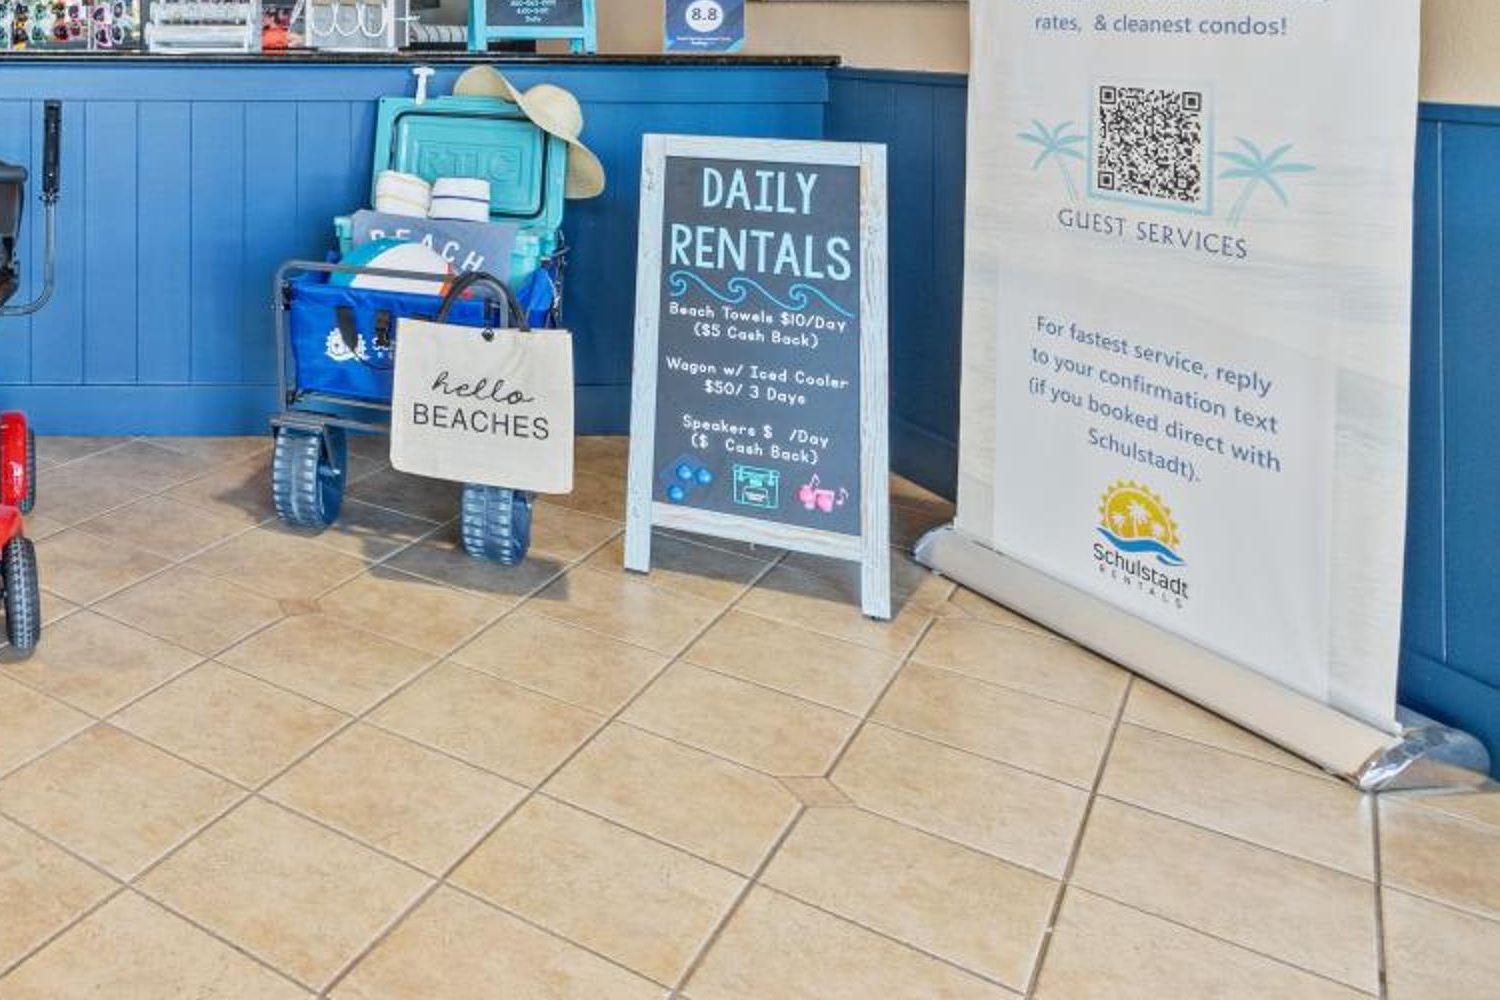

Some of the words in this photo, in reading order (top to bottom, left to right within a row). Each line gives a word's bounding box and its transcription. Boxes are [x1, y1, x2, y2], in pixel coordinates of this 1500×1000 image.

[691, 8, 717, 20] 8.8
[1035, 14, 1081, 33] rates,
[1093, 15, 1108, 31] &
[1113, 14, 1191, 33] cleanest
[1198, 16, 1287, 35] condos!
[702, 168, 818, 215] DAILY
[669, 223, 851, 281] RENTALS
[1058, 209, 1125, 237] GUEST
[1136, 221, 1249, 259] SERVICES
[669, 301, 715, 317] Beach
[722, 306, 774, 323] Towels
[780, 311, 847, 333] $10/Day
[693, 321, 721, 338] ($5
[727, 325, 765, 342] Cash
[771, 330, 819, 349] Back)
[666, 356, 717, 375] Wagon
[723, 365, 743, 377] w/
[750, 366, 787, 383] Iced
[794, 371, 849, 389] Cooler
[1037, 316, 1064, 336] For
[1069, 323, 1128, 355] fastest
[1134, 344, 1209, 380] service,
[1216, 366, 1272, 397] reply
[431, 371, 535, 404] hello
[704, 378, 742, 395] $50/
[749, 385, 759, 399] 3
[767, 387, 805, 405] Days
[1032, 348, 1049, 365] to
[1054, 355, 1094, 377] your
[1099, 368, 1226, 417] confirmation
[1233, 404, 1279, 434] text
[413, 403, 549, 440] BEACHES
[683, 414, 755, 438] Speakers
[763, 424, 773, 440] $
[789, 428, 829, 448] /Day
[1029, 376, 1047, 397] (if
[1051, 386, 1083, 408] you
[1088, 394, 1159, 432] booked
[1165, 421, 1225, 455] direct
[1231, 442, 1281, 472] with
[691, 433, 708, 449] ($
[725, 438, 764, 456] Cash
[771, 445, 819, 465] Back)
[1088, 427, 1200, 483] Schulstadt).
[1093, 543, 1189, 599] Schulstadt
[1100, 564, 1182, 609] RENTALS
